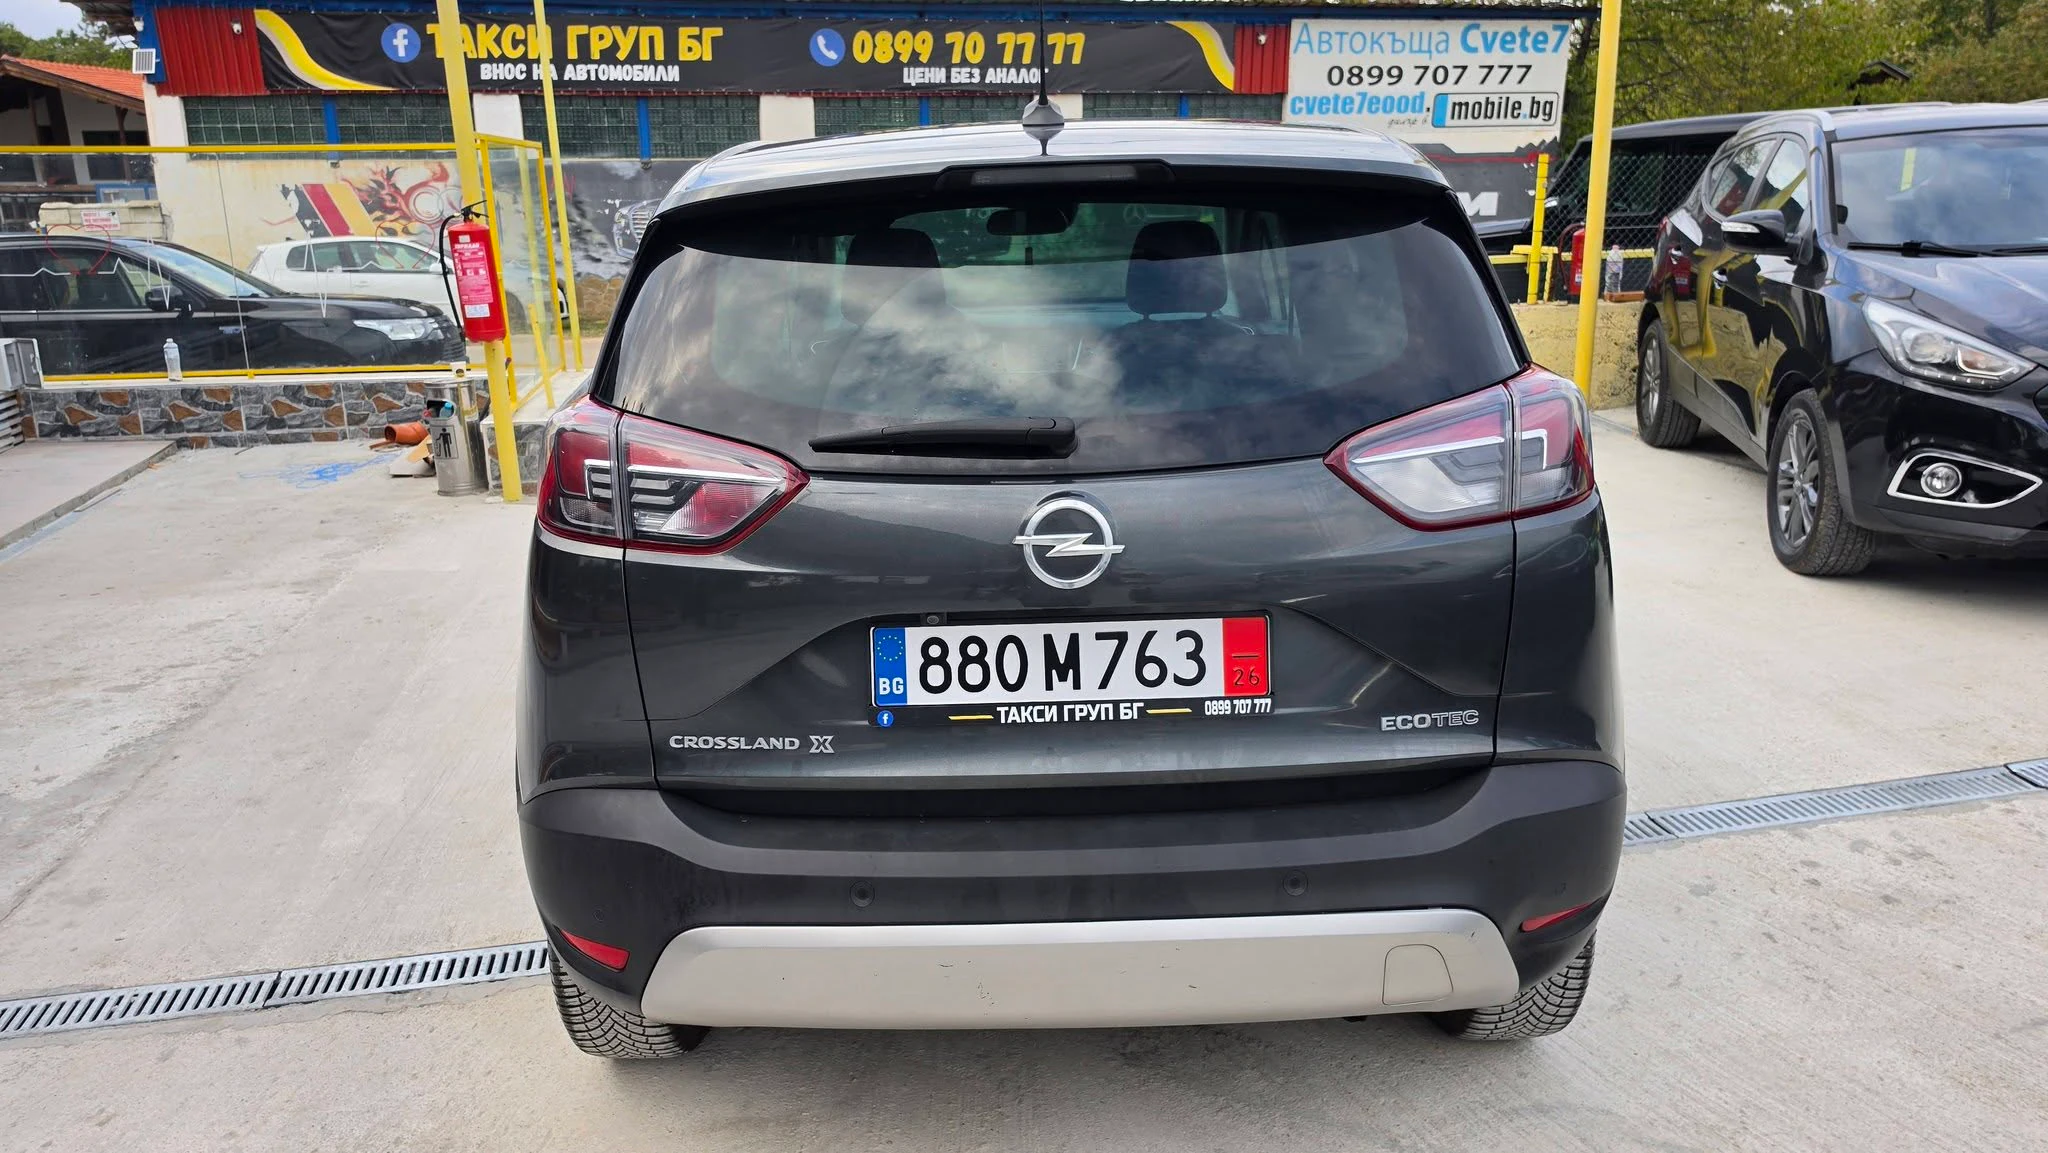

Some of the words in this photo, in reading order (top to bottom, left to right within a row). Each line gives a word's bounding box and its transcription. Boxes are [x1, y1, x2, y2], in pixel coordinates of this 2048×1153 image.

[567, 25, 664, 60] ГРУП
[678, 27, 723, 61] БГ
[852, 30, 934, 64] 0899
[945, 31, 985, 64] 70
[997, 32, 1035, 65] 77
[1047, 32, 1086, 65] 77
[1292, 22, 1450, 60] Автокъща
[1459, 23, 1570, 54] Cvete7
[480, 63, 527, 80] ВНОС
[563, 64, 680, 82] АВТОМОБИЛИ
[902, 67, 946, 86] ЦЕНИ
[950, 67, 981, 84] БЕЗ
[1327, 65, 1404, 86] 0899
[1413, 65, 1468, 86] 707
[1478, 64, 1533, 85] 777
[1450, 96, 1554, 122] mobile.bg
[918, 634, 1028, 695] 880
[1042, 632, 1081, 692] M
[1095, 629, 1206, 690] 763
[879, 676, 904, 695] BG
[1232, 667, 1261, 687] 26
[997, 706, 1059, 724] ТАКСИ
[1063, 705, 1113, 721] ГРУП
[1118, 702, 1144, 721] БГ
[1204, 700, 1232, 716] 0899
[1233, 699, 1253, 714] 707
[1253, 698, 1272, 714] 777
[1380, 709, 1479, 731] ECOTEC
[669, 735, 800, 750] CROSSLAND
[809, 735, 835, 754] X
